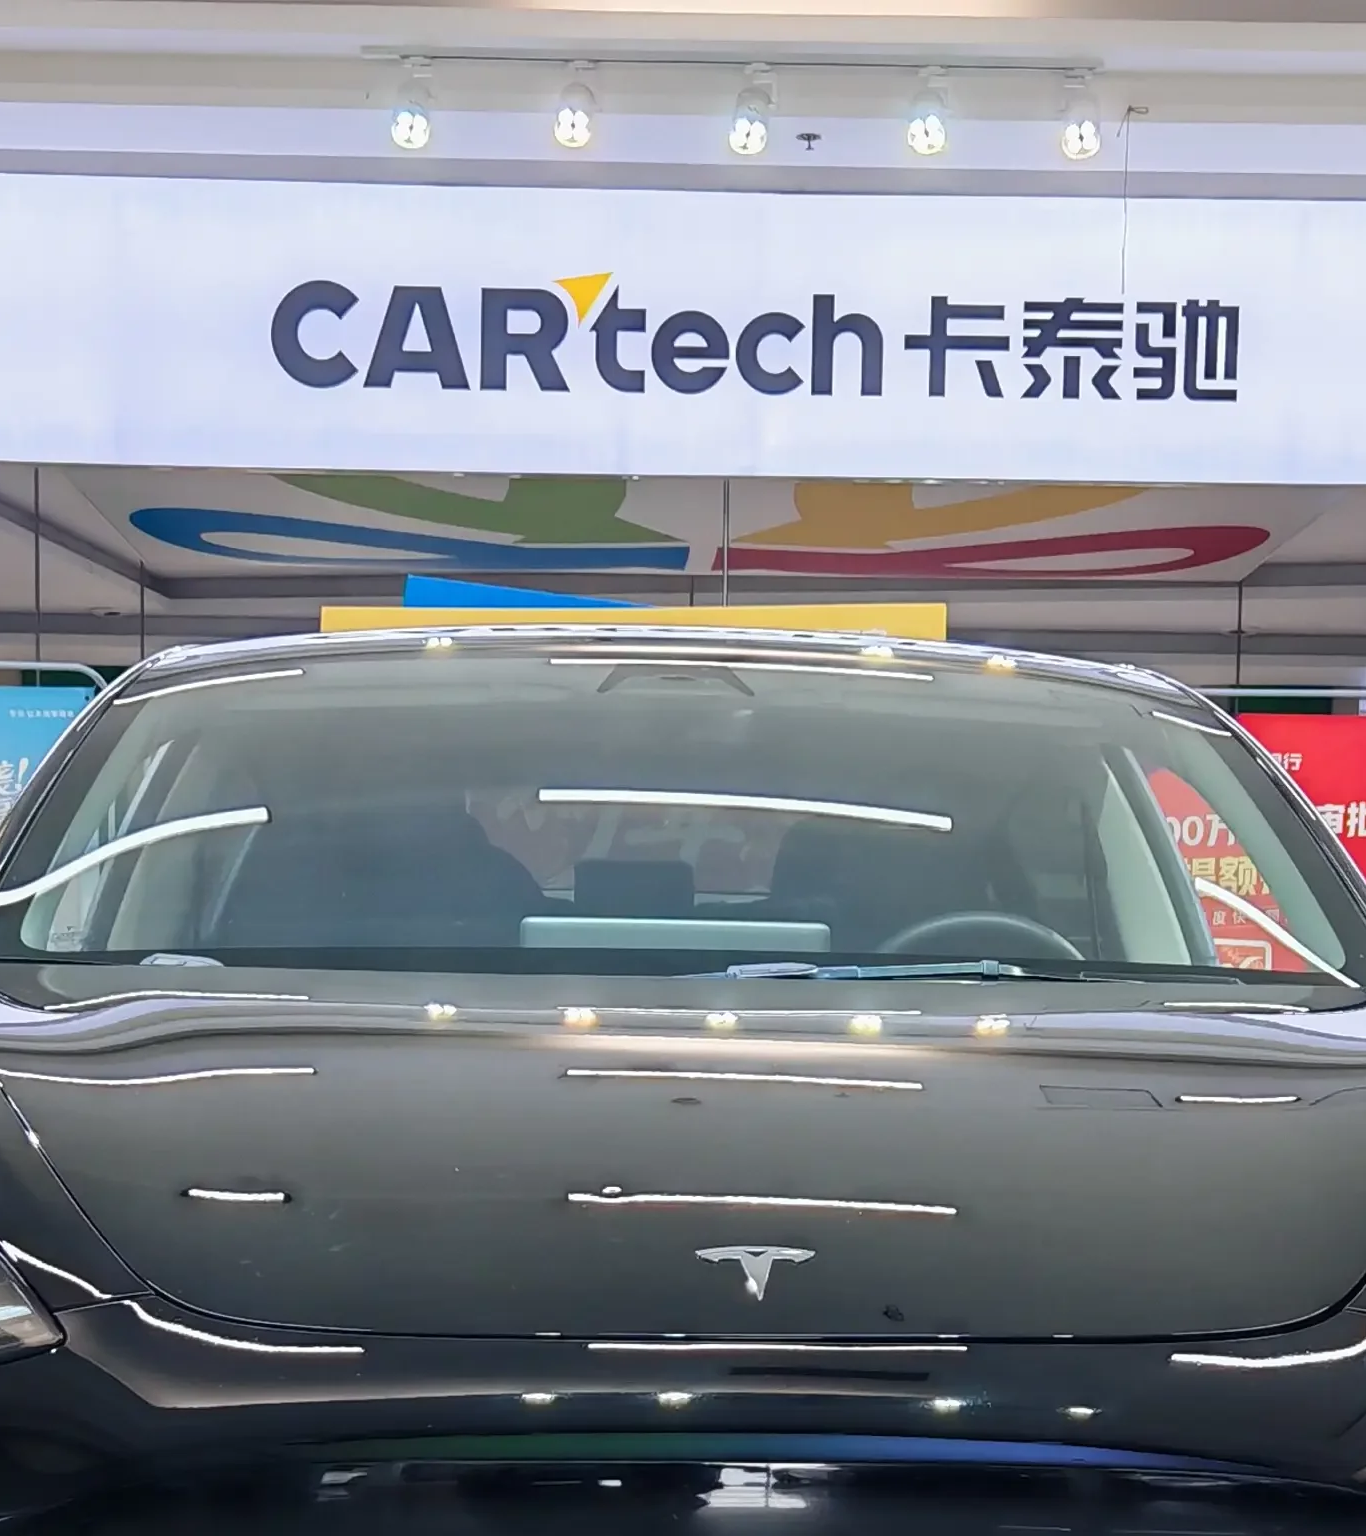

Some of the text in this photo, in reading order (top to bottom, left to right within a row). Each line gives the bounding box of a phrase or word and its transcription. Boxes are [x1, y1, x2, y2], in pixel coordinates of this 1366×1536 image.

[271, 278, 1240, 401] CARtech 卡泰驰
